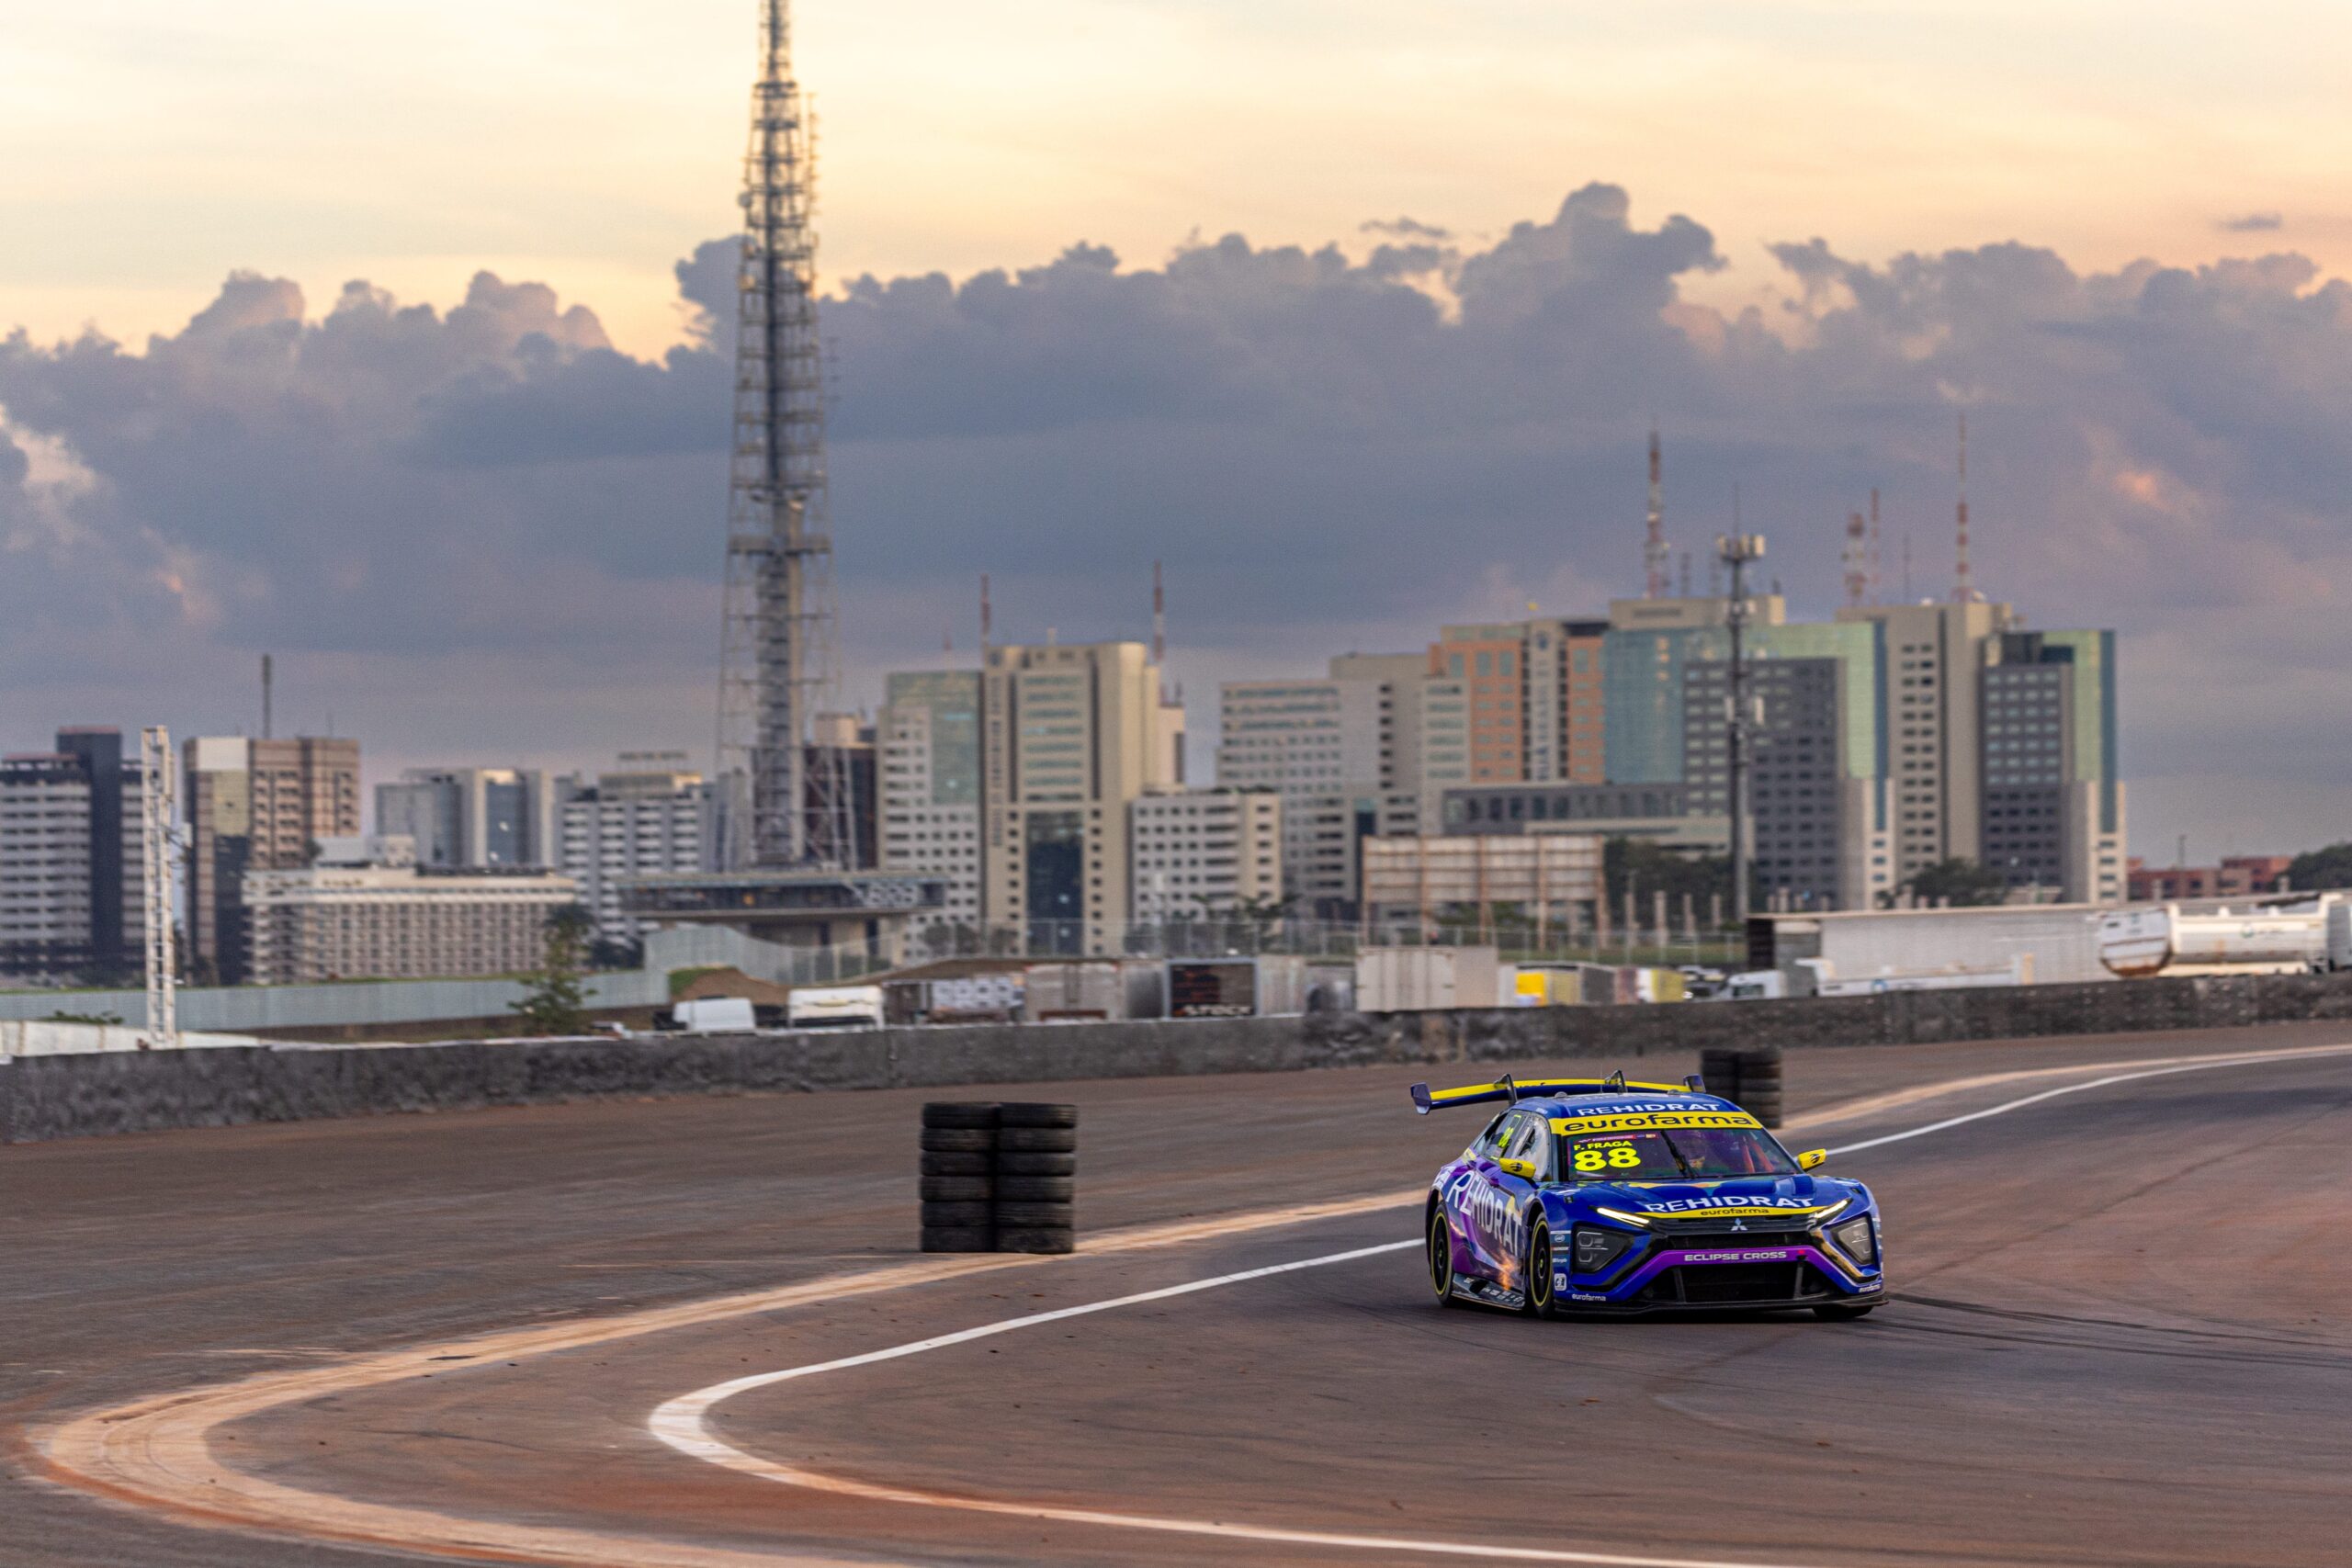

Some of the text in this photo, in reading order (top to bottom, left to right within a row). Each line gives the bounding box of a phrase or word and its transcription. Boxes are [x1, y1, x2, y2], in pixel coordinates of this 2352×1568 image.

[1577, 1103, 1721, 1117] REHIDRAT
[1564, 1114, 1755, 1132] eurofarma
[1574, 1140, 1633, 1151] F. FRAGA
[1574, 1147, 1642, 1171] 88
[1645, 1196, 1815, 1213] REHIDRAT
[1701, 1207, 1770, 1216] eurofarma
[1446, 1169, 1522, 1257] REHIDRAT
[1684, 1251, 1787, 1262] ECLIPSE CROSS
[1571, 1293, 1607, 1302] eurofarma
